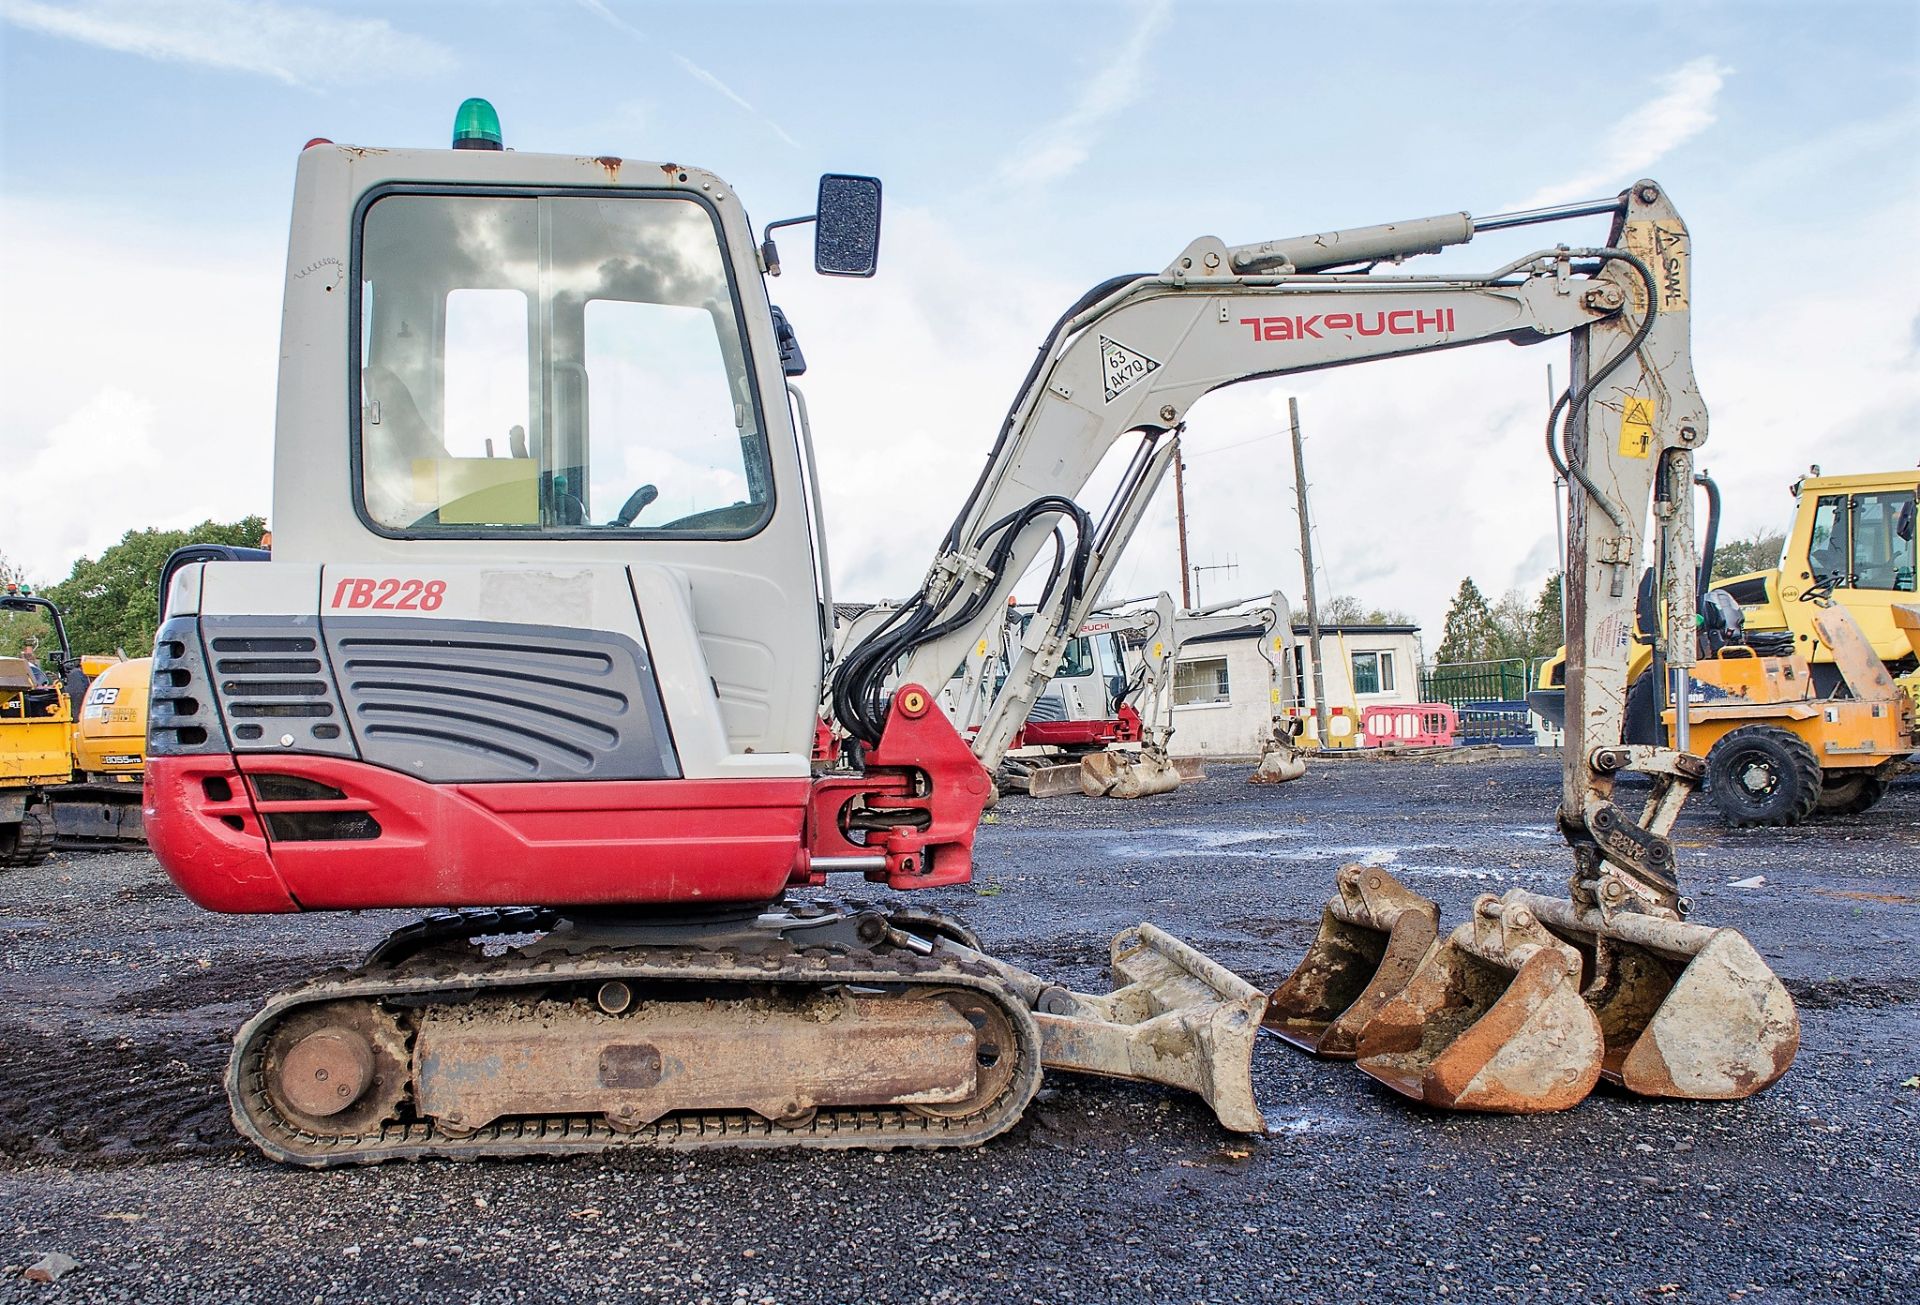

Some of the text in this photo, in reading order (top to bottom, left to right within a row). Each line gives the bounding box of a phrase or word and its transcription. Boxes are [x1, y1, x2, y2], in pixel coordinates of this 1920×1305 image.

[1664, 257, 1682, 307] SWL
[1109, 350, 1126, 369] 63
[1110, 359, 1145, 389] AK7Q
[331, 578, 447, 611] TB228
[86, 688, 119, 704] JCB
[1613, 869, 1649, 895] WARNING
